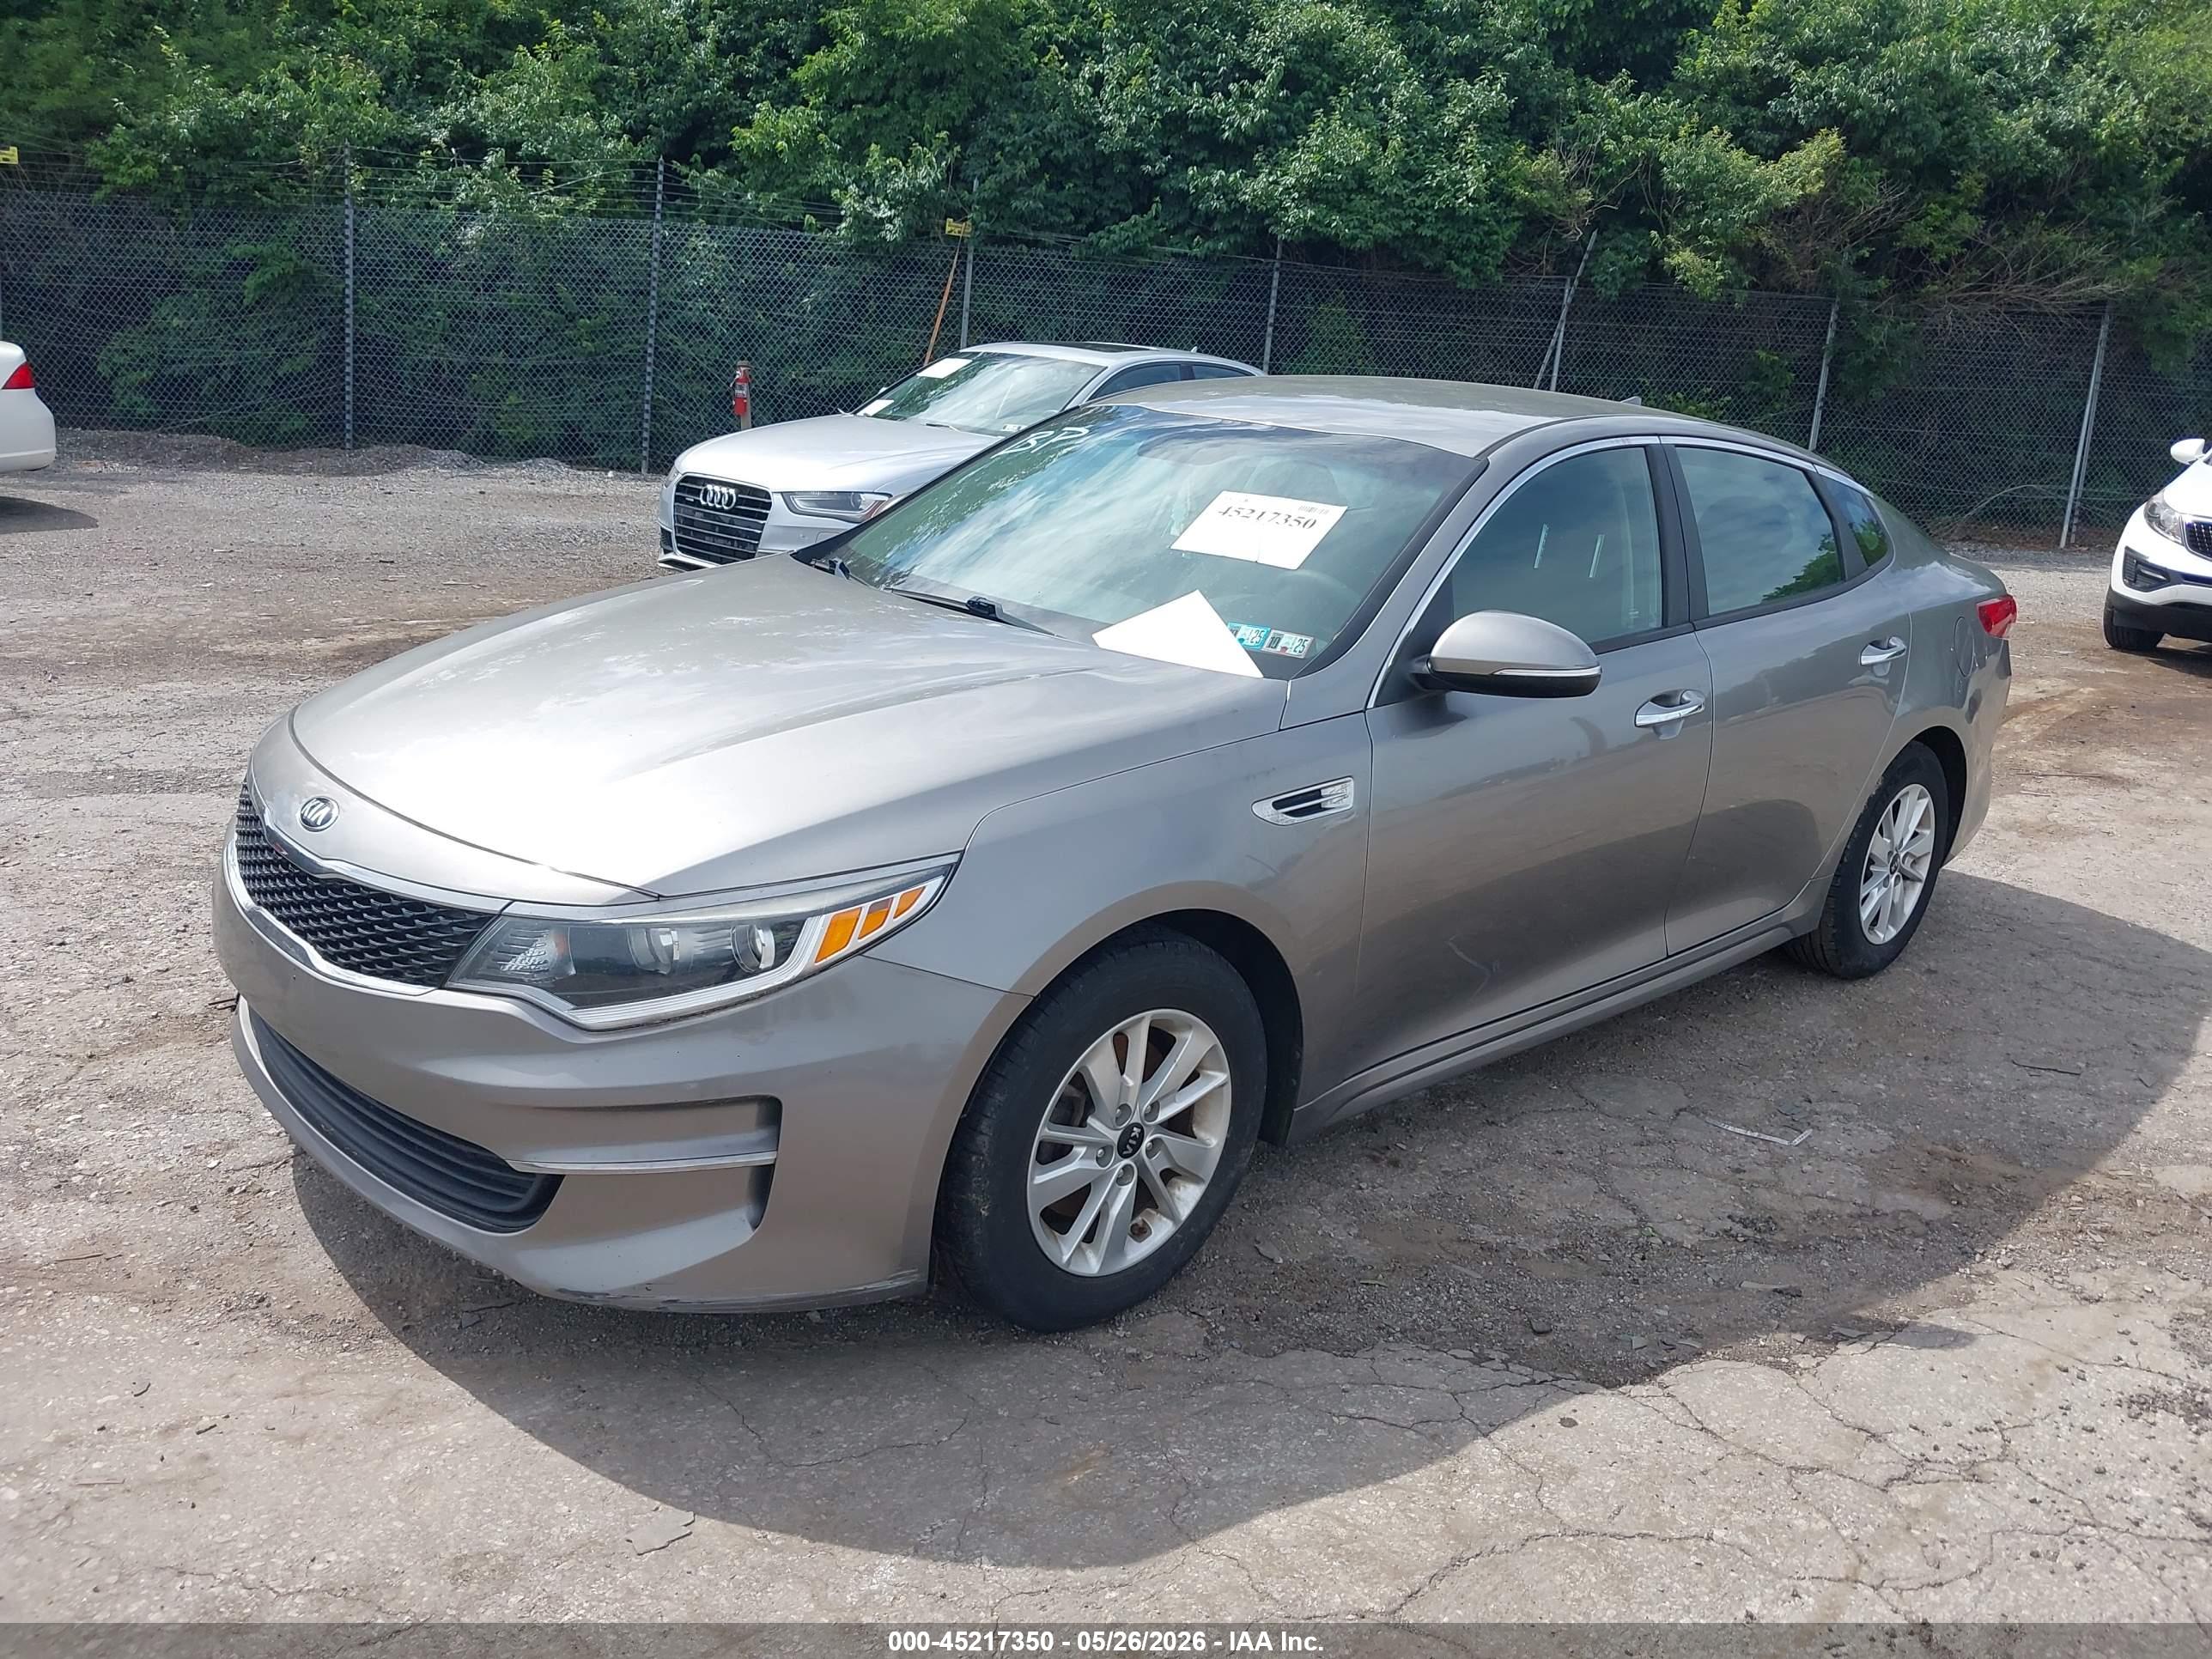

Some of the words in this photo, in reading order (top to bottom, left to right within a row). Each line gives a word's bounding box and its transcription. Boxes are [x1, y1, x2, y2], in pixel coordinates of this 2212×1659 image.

[1218, 506, 1318, 529] 45217350
[1250, 629, 1265, 644] 25
[1267, 635, 1282, 649] 10
[1293, 638, 1309, 654] 25
[1122, 1127, 1141, 1155] KIA
